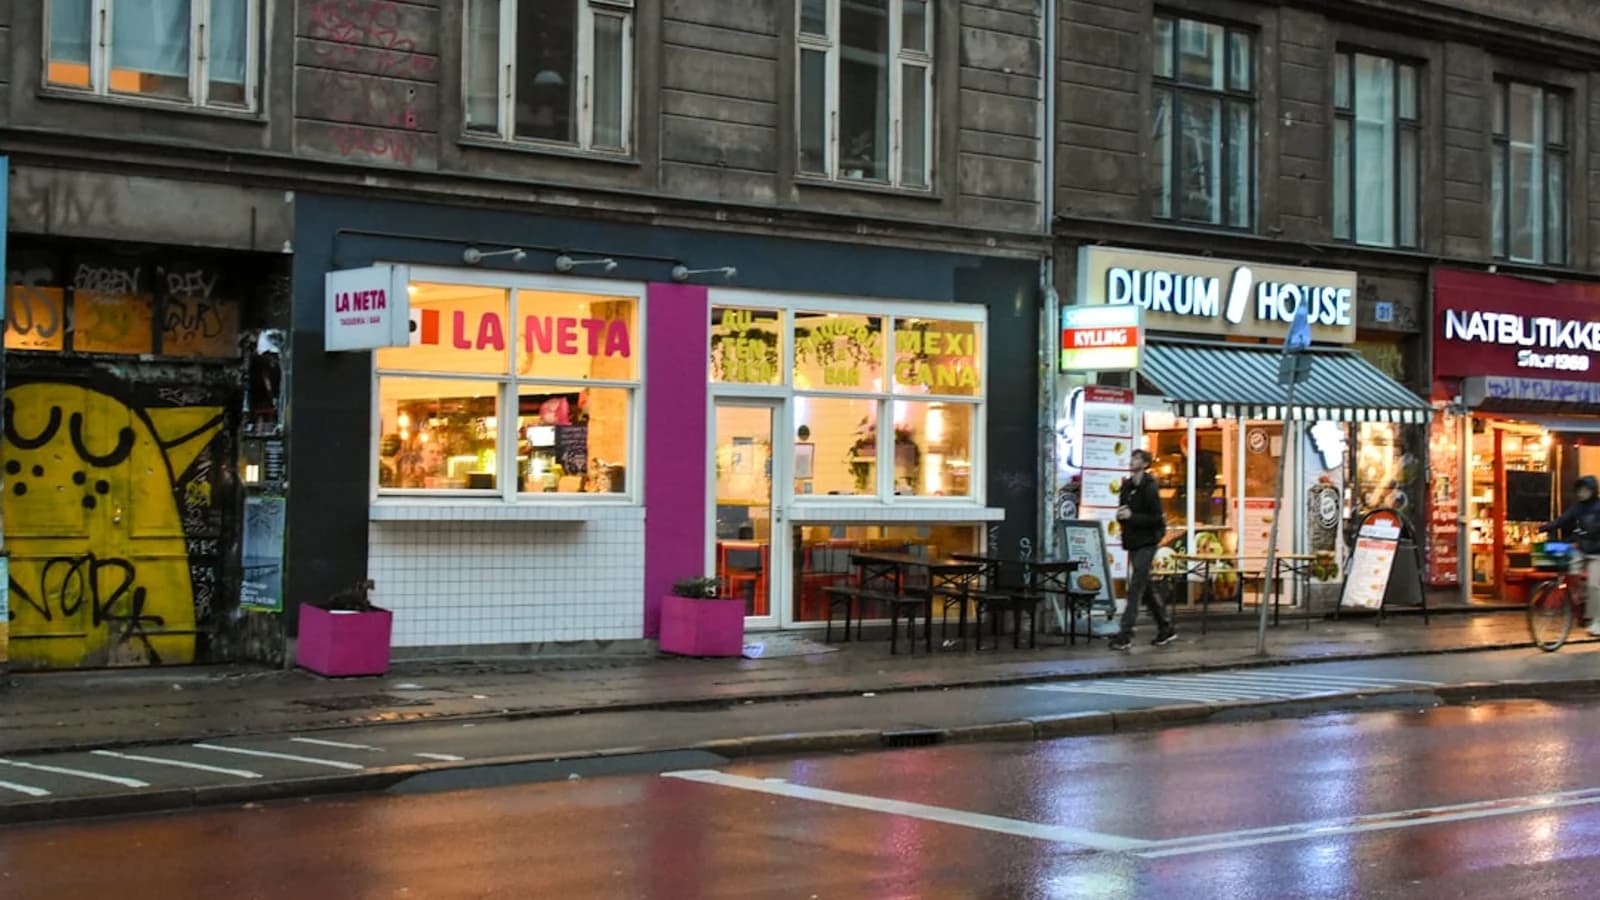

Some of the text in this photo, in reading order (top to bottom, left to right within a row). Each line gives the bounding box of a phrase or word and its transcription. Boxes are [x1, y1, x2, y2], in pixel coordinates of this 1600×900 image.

[335, 289, 386, 313] LA NETA
[1108, 267, 1352, 326] DURUM HOUSE
[452, 310, 631, 358] LA NETA
[895, 331, 976, 356] MEXI
[1073, 328, 1128, 347] KYLLING
[1517, 349, 1554, 368] Since
[722, 359, 773, 384] TICA
[824, 367, 860, 386] BAR
[895, 363, 978, 388] CANA
